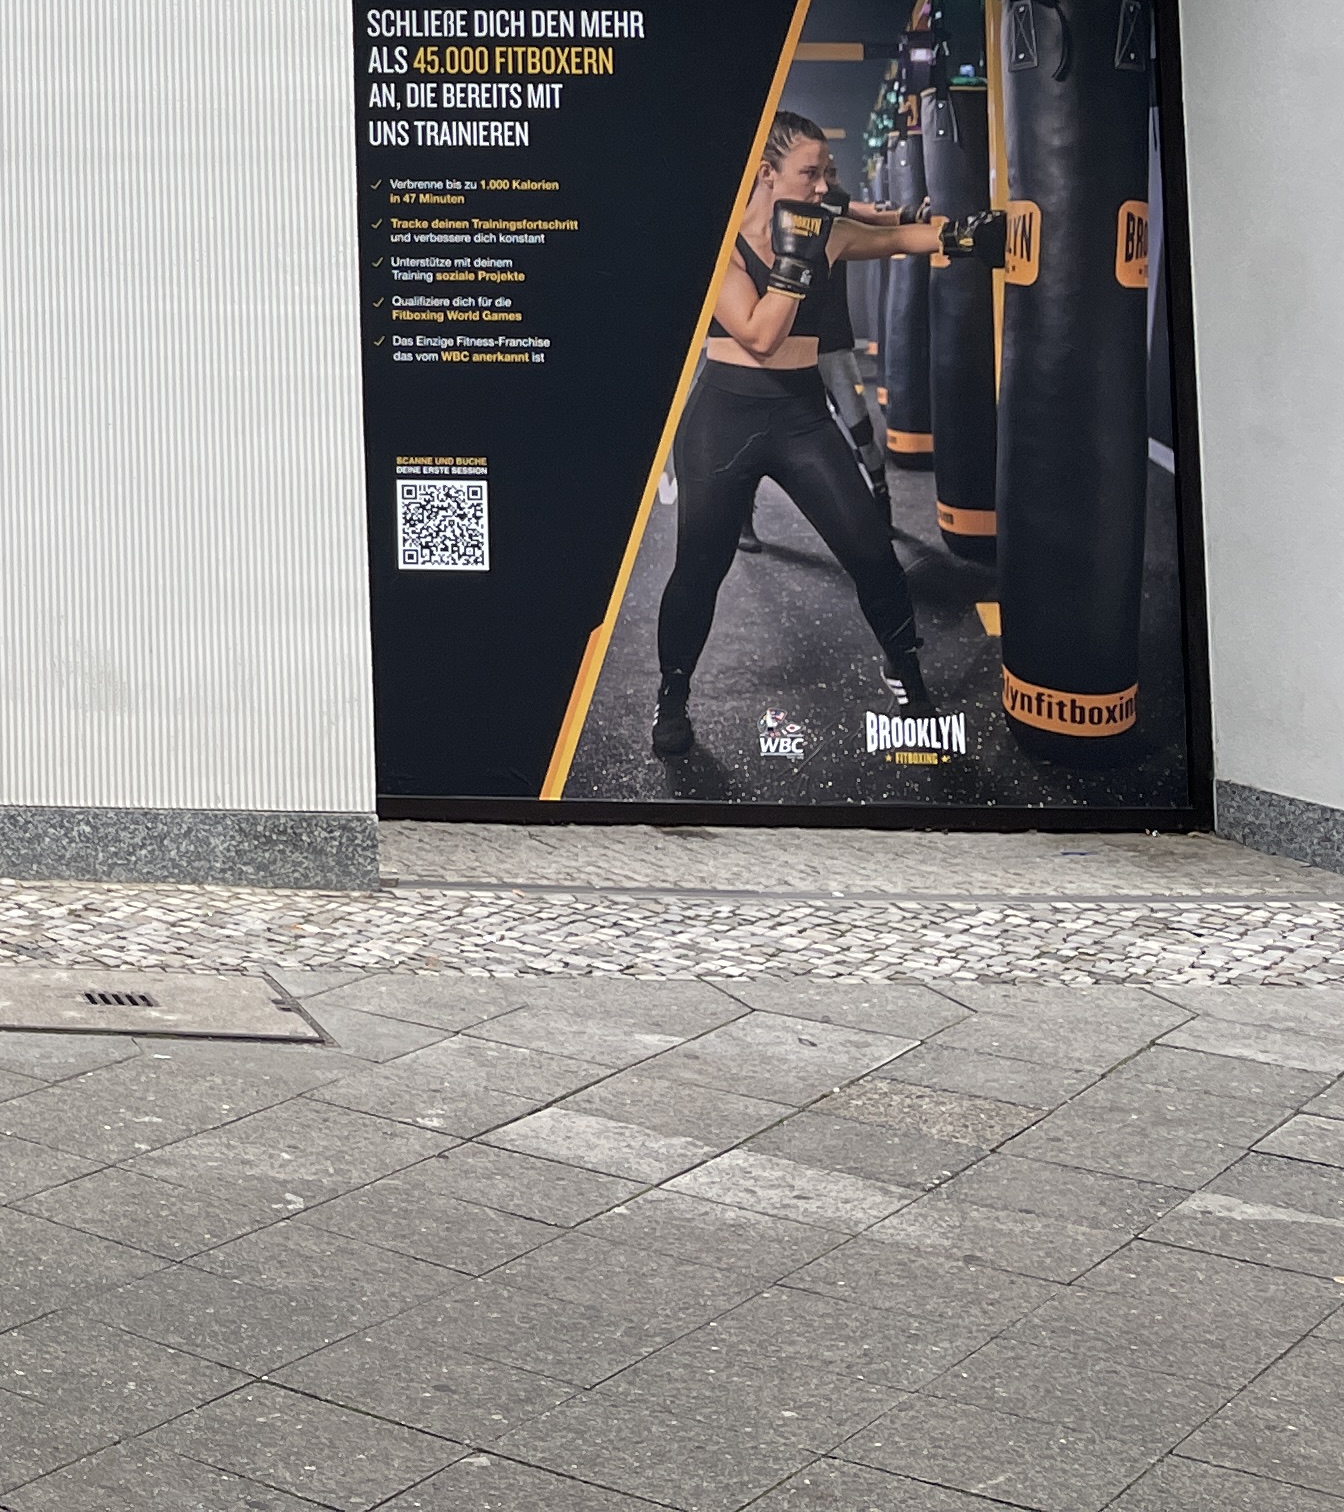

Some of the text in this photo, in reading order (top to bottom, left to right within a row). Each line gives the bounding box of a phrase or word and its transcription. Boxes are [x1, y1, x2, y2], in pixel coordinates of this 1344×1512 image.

[474, 10, 524, 38] DICH
[532, 11, 574, 38] DEN
[581, 11, 644, 39] MEHR
[368, 46, 614, 75] ALS 45.000 FITBOXERN
[369, 83, 562, 111] AN, DIE BEREITS MIT
[369, 121, 529, 147] UNS TRAINIEREN
[390, 179, 443, 189] Verbrenne
[446, 180, 461, 189] bis
[480, 180, 509, 190] 1.000
[512, 180, 559, 190] Kalorien
[390, 194, 464, 204] in 47 Minuten
[391, 218, 578, 231] Tracke deinen Trainingsfortschritt
[391, 233, 545, 243] und verbessere dich konstant
[391, 257, 512, 268] Unterstütze mit deinem
[392, 270, 525, 283] Training soziale Projekte
[392, 296, 511, 307] Qualifiziere dich für die
[392, 310, 522, 322] Fitboxing World Games
[393, 336, 550, 348] Das Einzige Fitness-Franchise
[393, 351, 544, 363] das vom WBC anerkannt ist
[435, 456, 454, 465] UND
[456, 457, 487, 465] BUCHE
[1004, 675, 1137, 726] lynfitboxin
[866, 710, 966, 754] BROOKLYN
[760, 737, 804, 753] WBC
